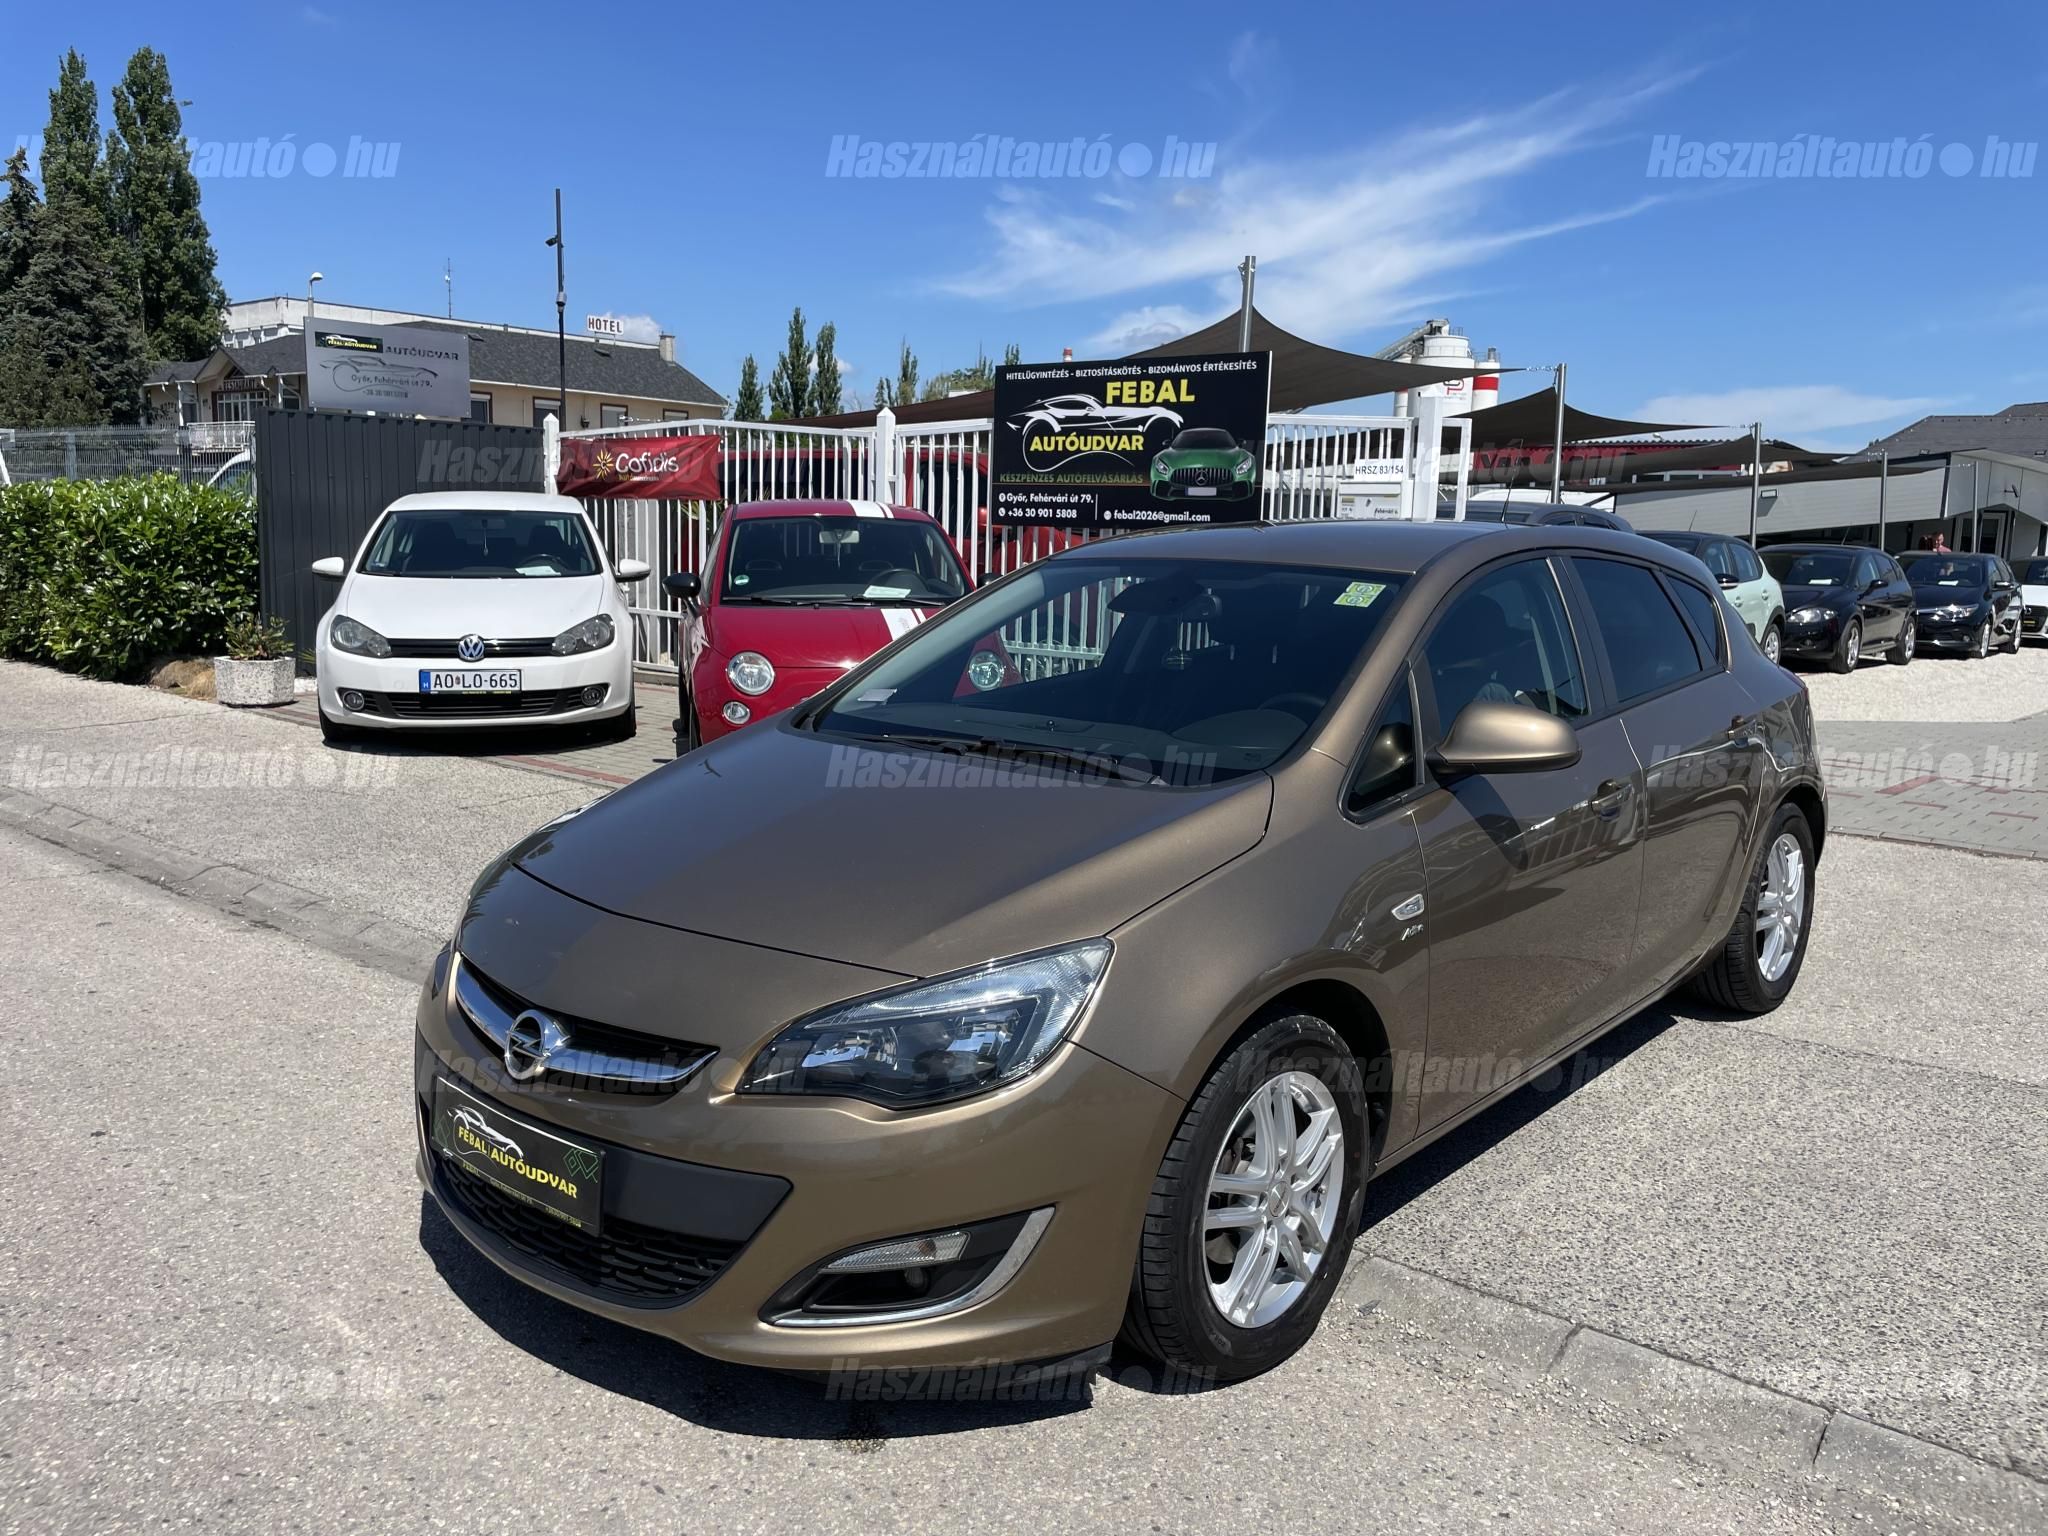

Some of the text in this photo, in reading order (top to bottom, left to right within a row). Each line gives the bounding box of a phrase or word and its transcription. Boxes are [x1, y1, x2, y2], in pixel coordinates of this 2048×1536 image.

[588, 316, 623, 334] HOTEL
[1006, 370, 1069, 381] HITELÜGYINTÉZÉS
[1075, 366, 1142, 378] BIZTOSÍTÁSKÖTÉS
[1148, 362, 1201, 374] BIZOMÁNYOS
[1202, 360, 1257, 372] ÉRTÉKESÍTÉS
[1105, 379, 1196, 405] FEBAL
[1029, 431, 1145, 452] AUTÓUDVAR
[615, 452, 680, 473] Cofidis
[1355, 465, 1404, 475] HRSZ 83/154
[1006, 493, 1094, 504] Győr, Fehérvári út 79.
[1007, 508, 1077, 519] +36 30 901 5808
[1113, 510, 1211, 522] febal2026@gmail.com
[433, 673, 454, 689] AO
[458, 1126, 578, 1199] FEBAL AUTÓUDVAR
